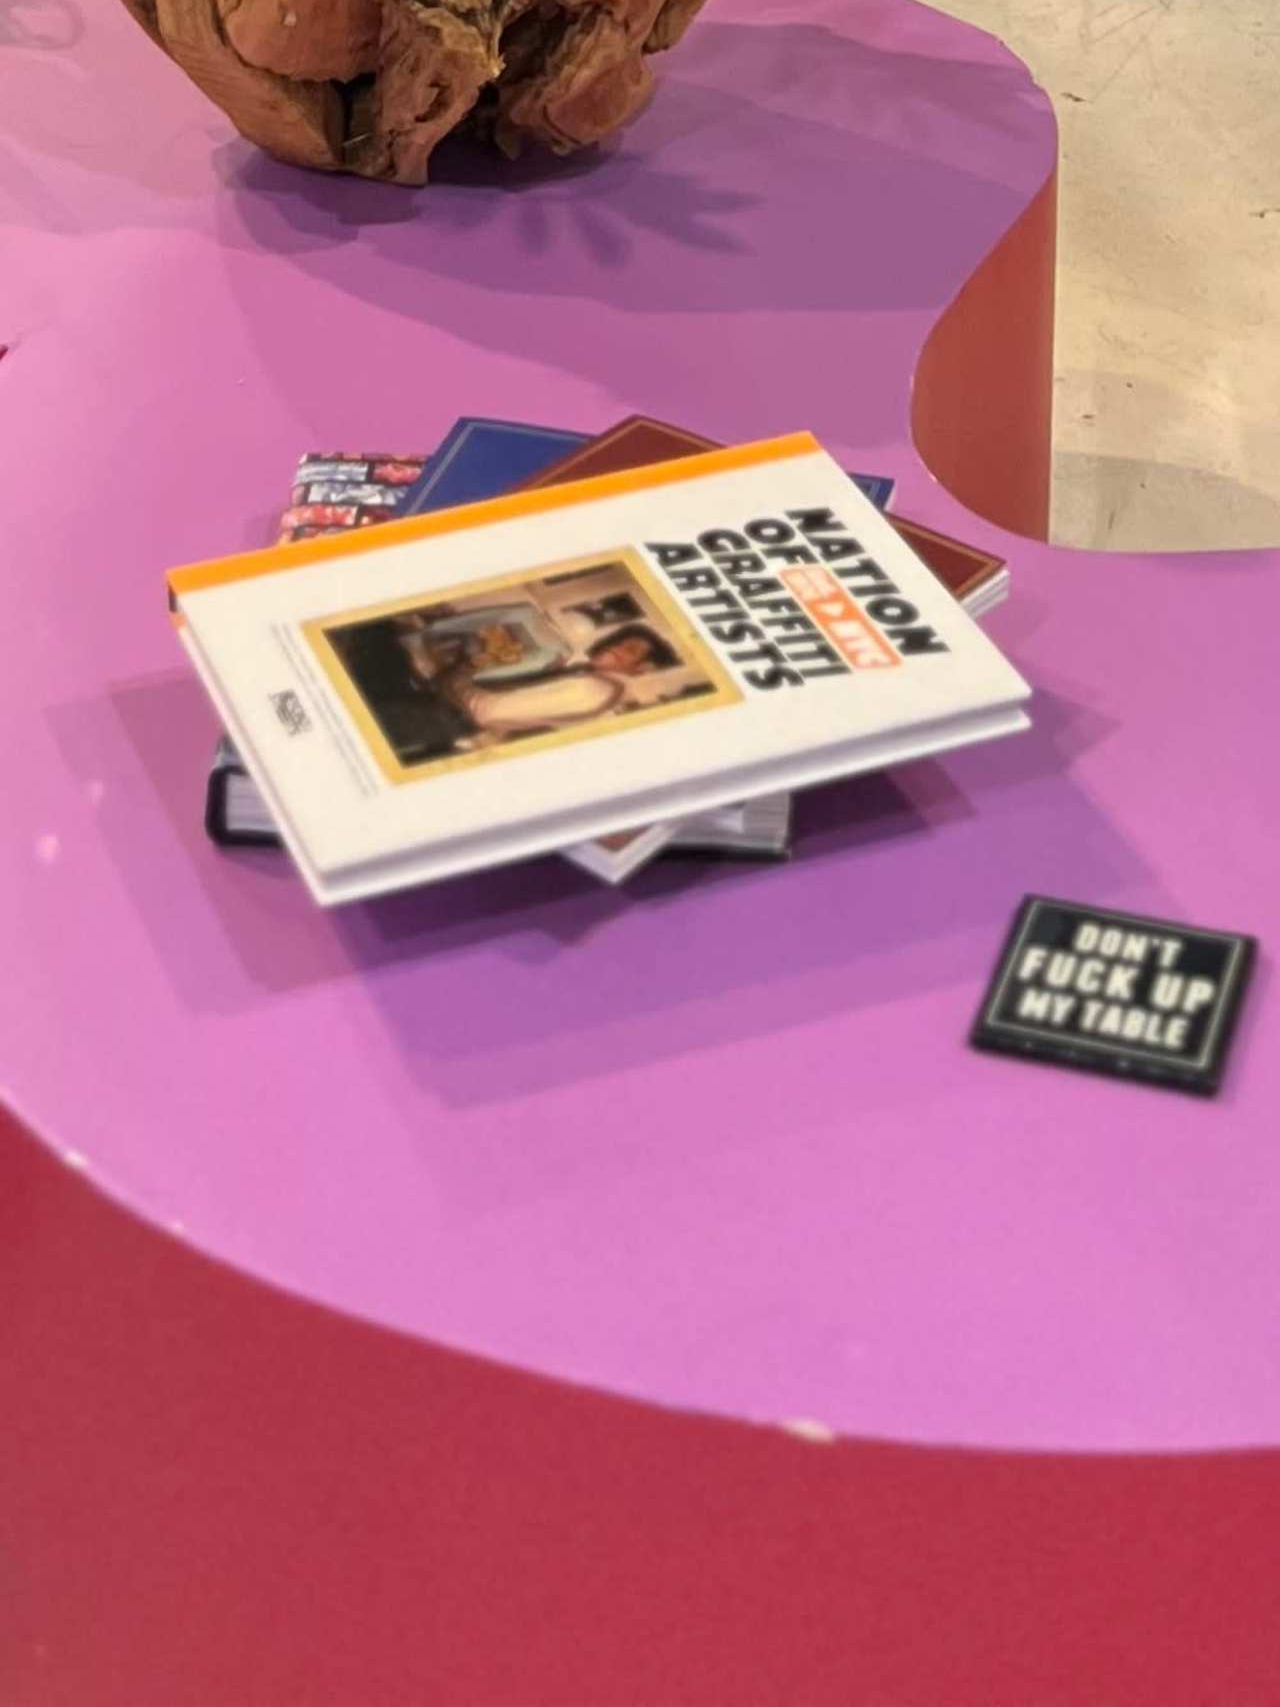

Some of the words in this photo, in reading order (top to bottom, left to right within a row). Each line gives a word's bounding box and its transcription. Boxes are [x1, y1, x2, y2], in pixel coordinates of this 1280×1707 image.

[744, 518, 814, 568] OF
[697, 527, 853, 678] GRAFFITI
[786, 506, 951, 656] NATION
[644, 541, 804, 692] ARTISTS
[1074, 922, 1183, 967] DON'T
[1019, 947, 1139, 1000] FUCK
[1150, 972, 1215, 1014] UP
[1018, 988, 1075, 1025] MY
[1080, 999, 1189, 1050] TABLE
